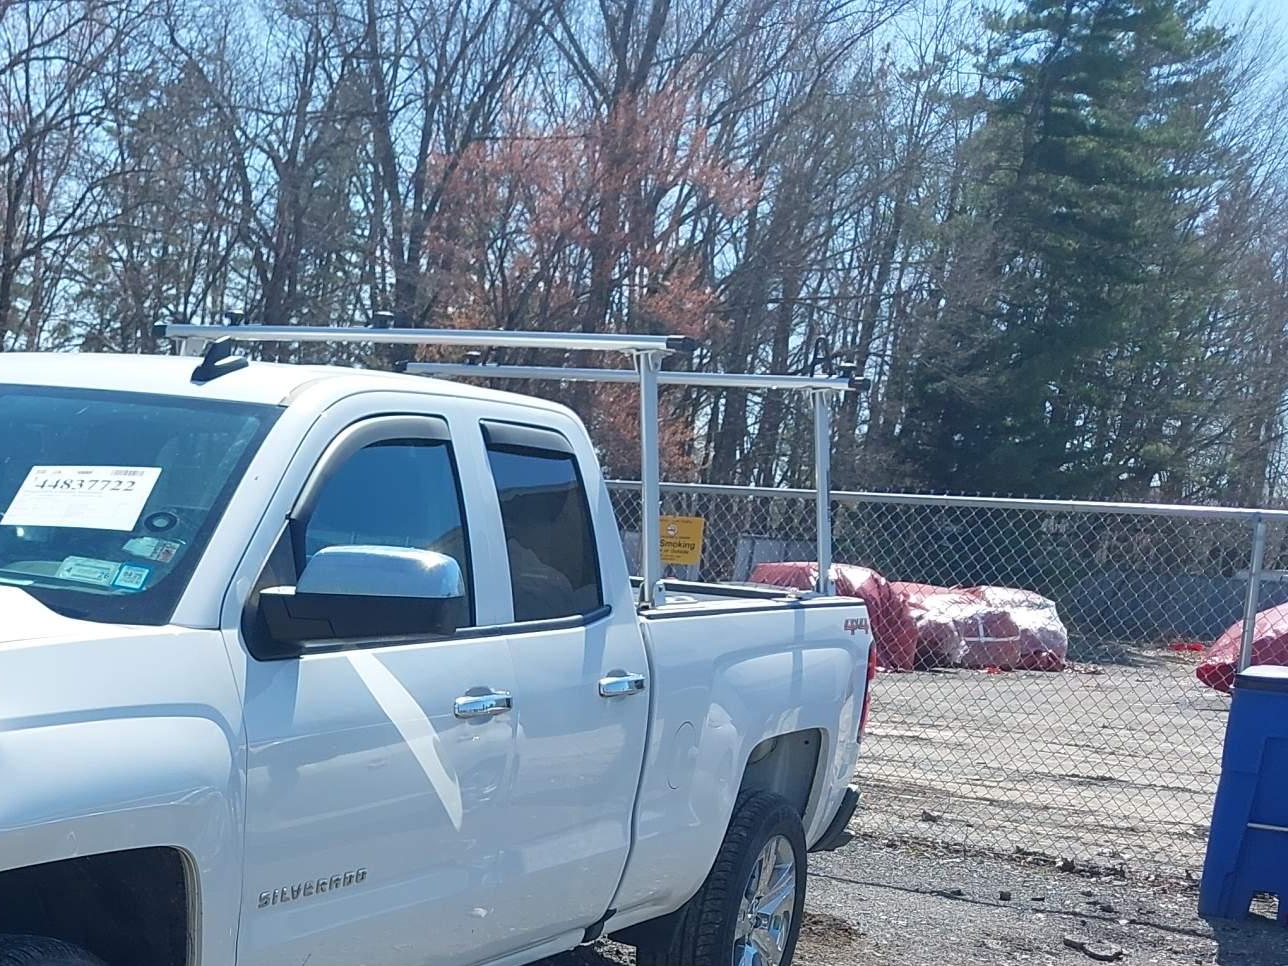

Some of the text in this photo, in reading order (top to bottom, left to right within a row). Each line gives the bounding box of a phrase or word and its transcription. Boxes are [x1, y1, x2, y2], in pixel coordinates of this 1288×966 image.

[35, 479, 137, 492] 44837722
[659, 539, 696, 551] Smoking
[257, 867, 368, 909] SILVERADO
